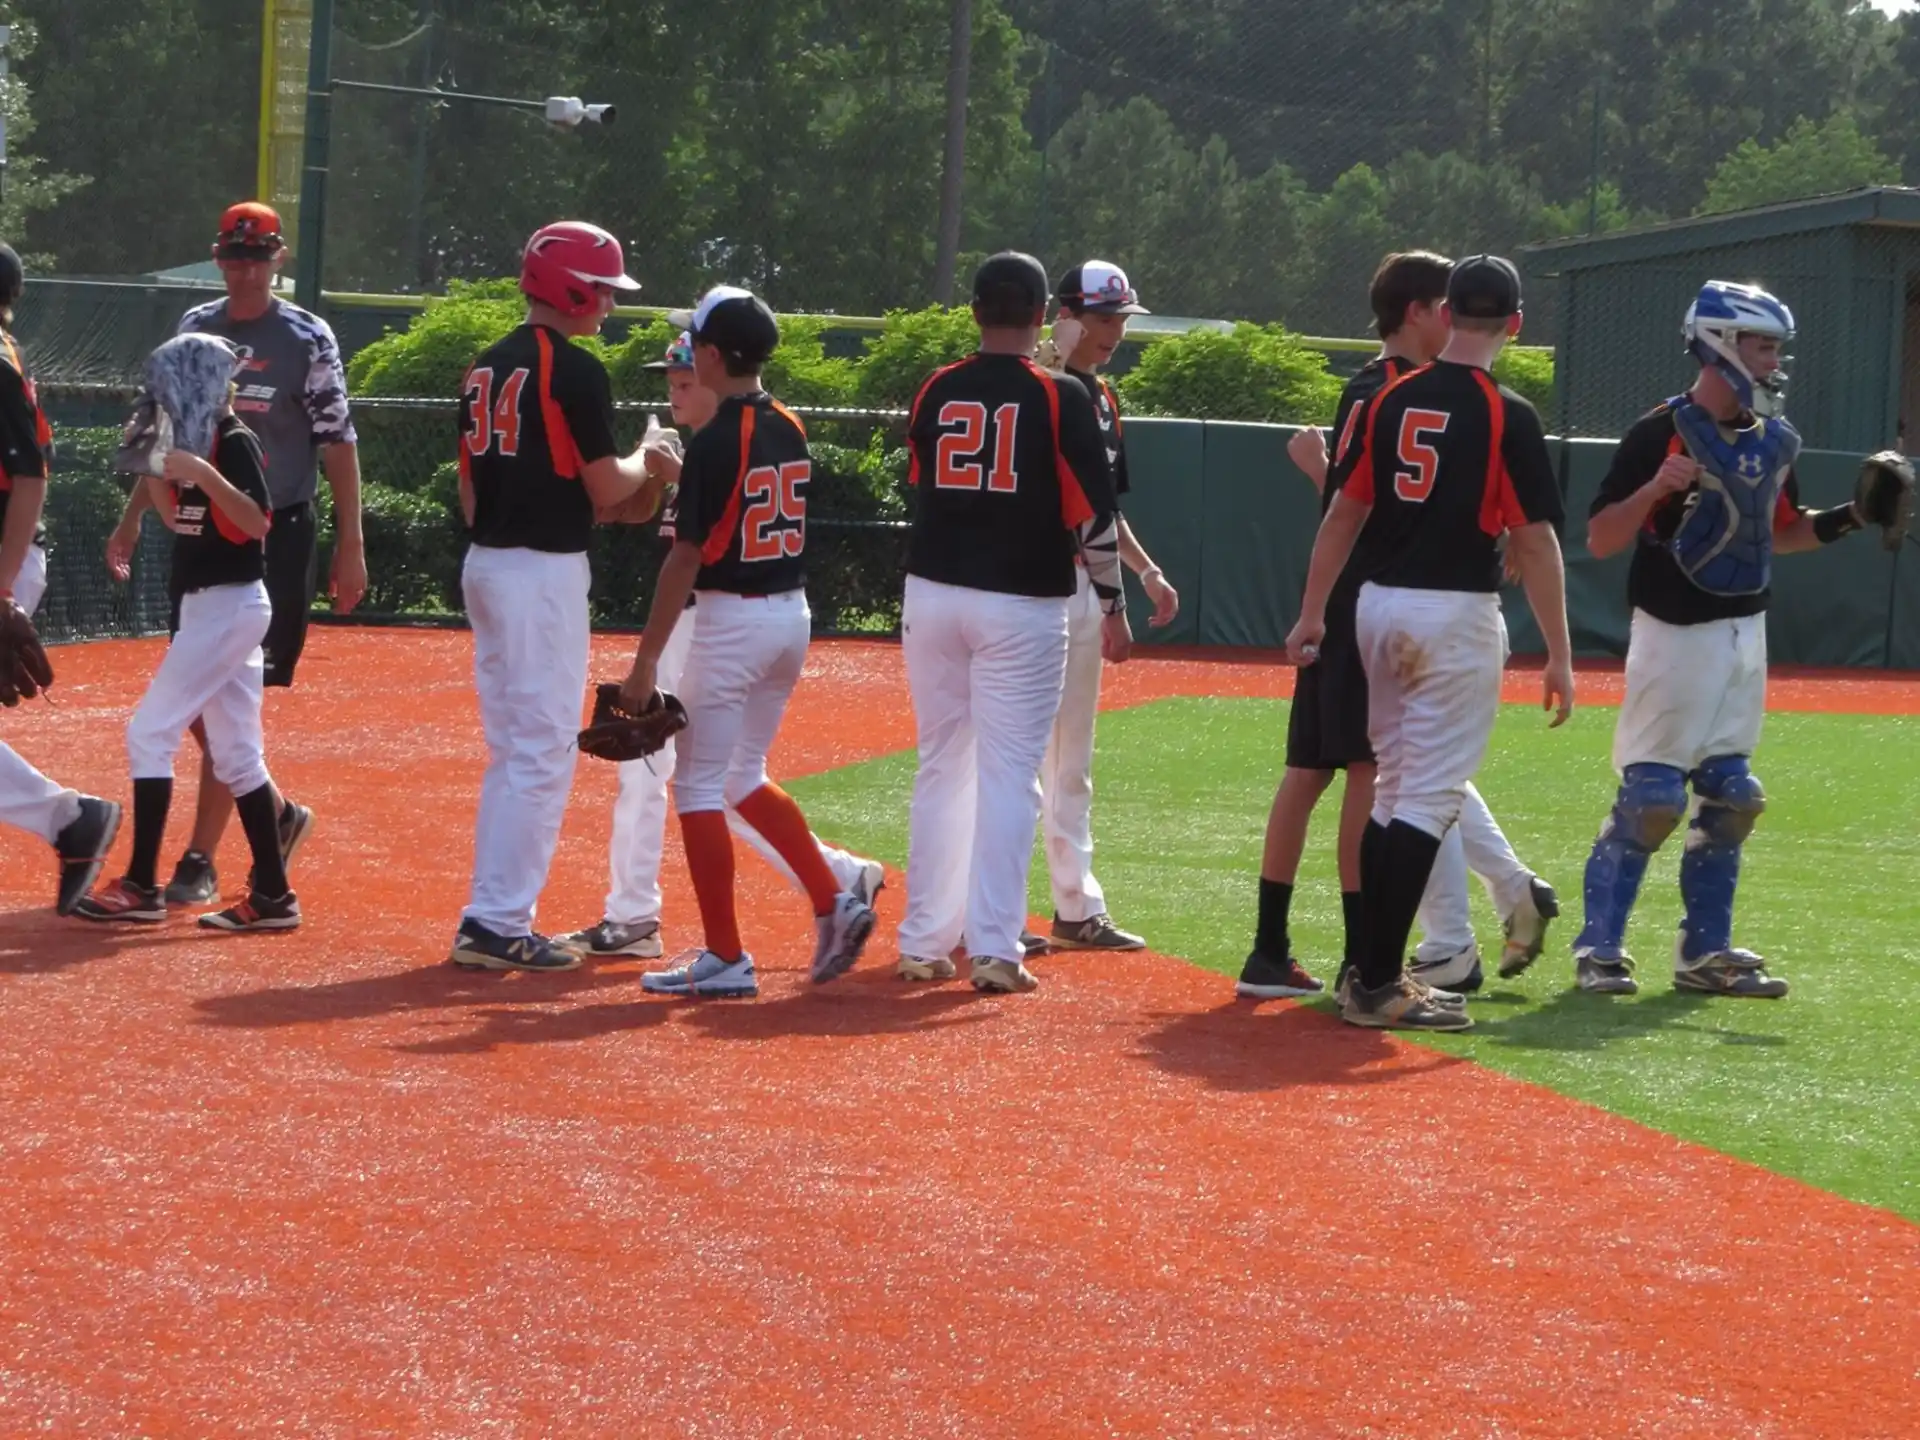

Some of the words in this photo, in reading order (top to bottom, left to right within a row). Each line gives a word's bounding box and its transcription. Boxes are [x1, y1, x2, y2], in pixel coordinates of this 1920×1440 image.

[464, 367, 530, 456] 34
[936, 401, 1020, 493] 21
[1394, 407, 1451, 503] 5
[741, 460, 811, 562] 25
